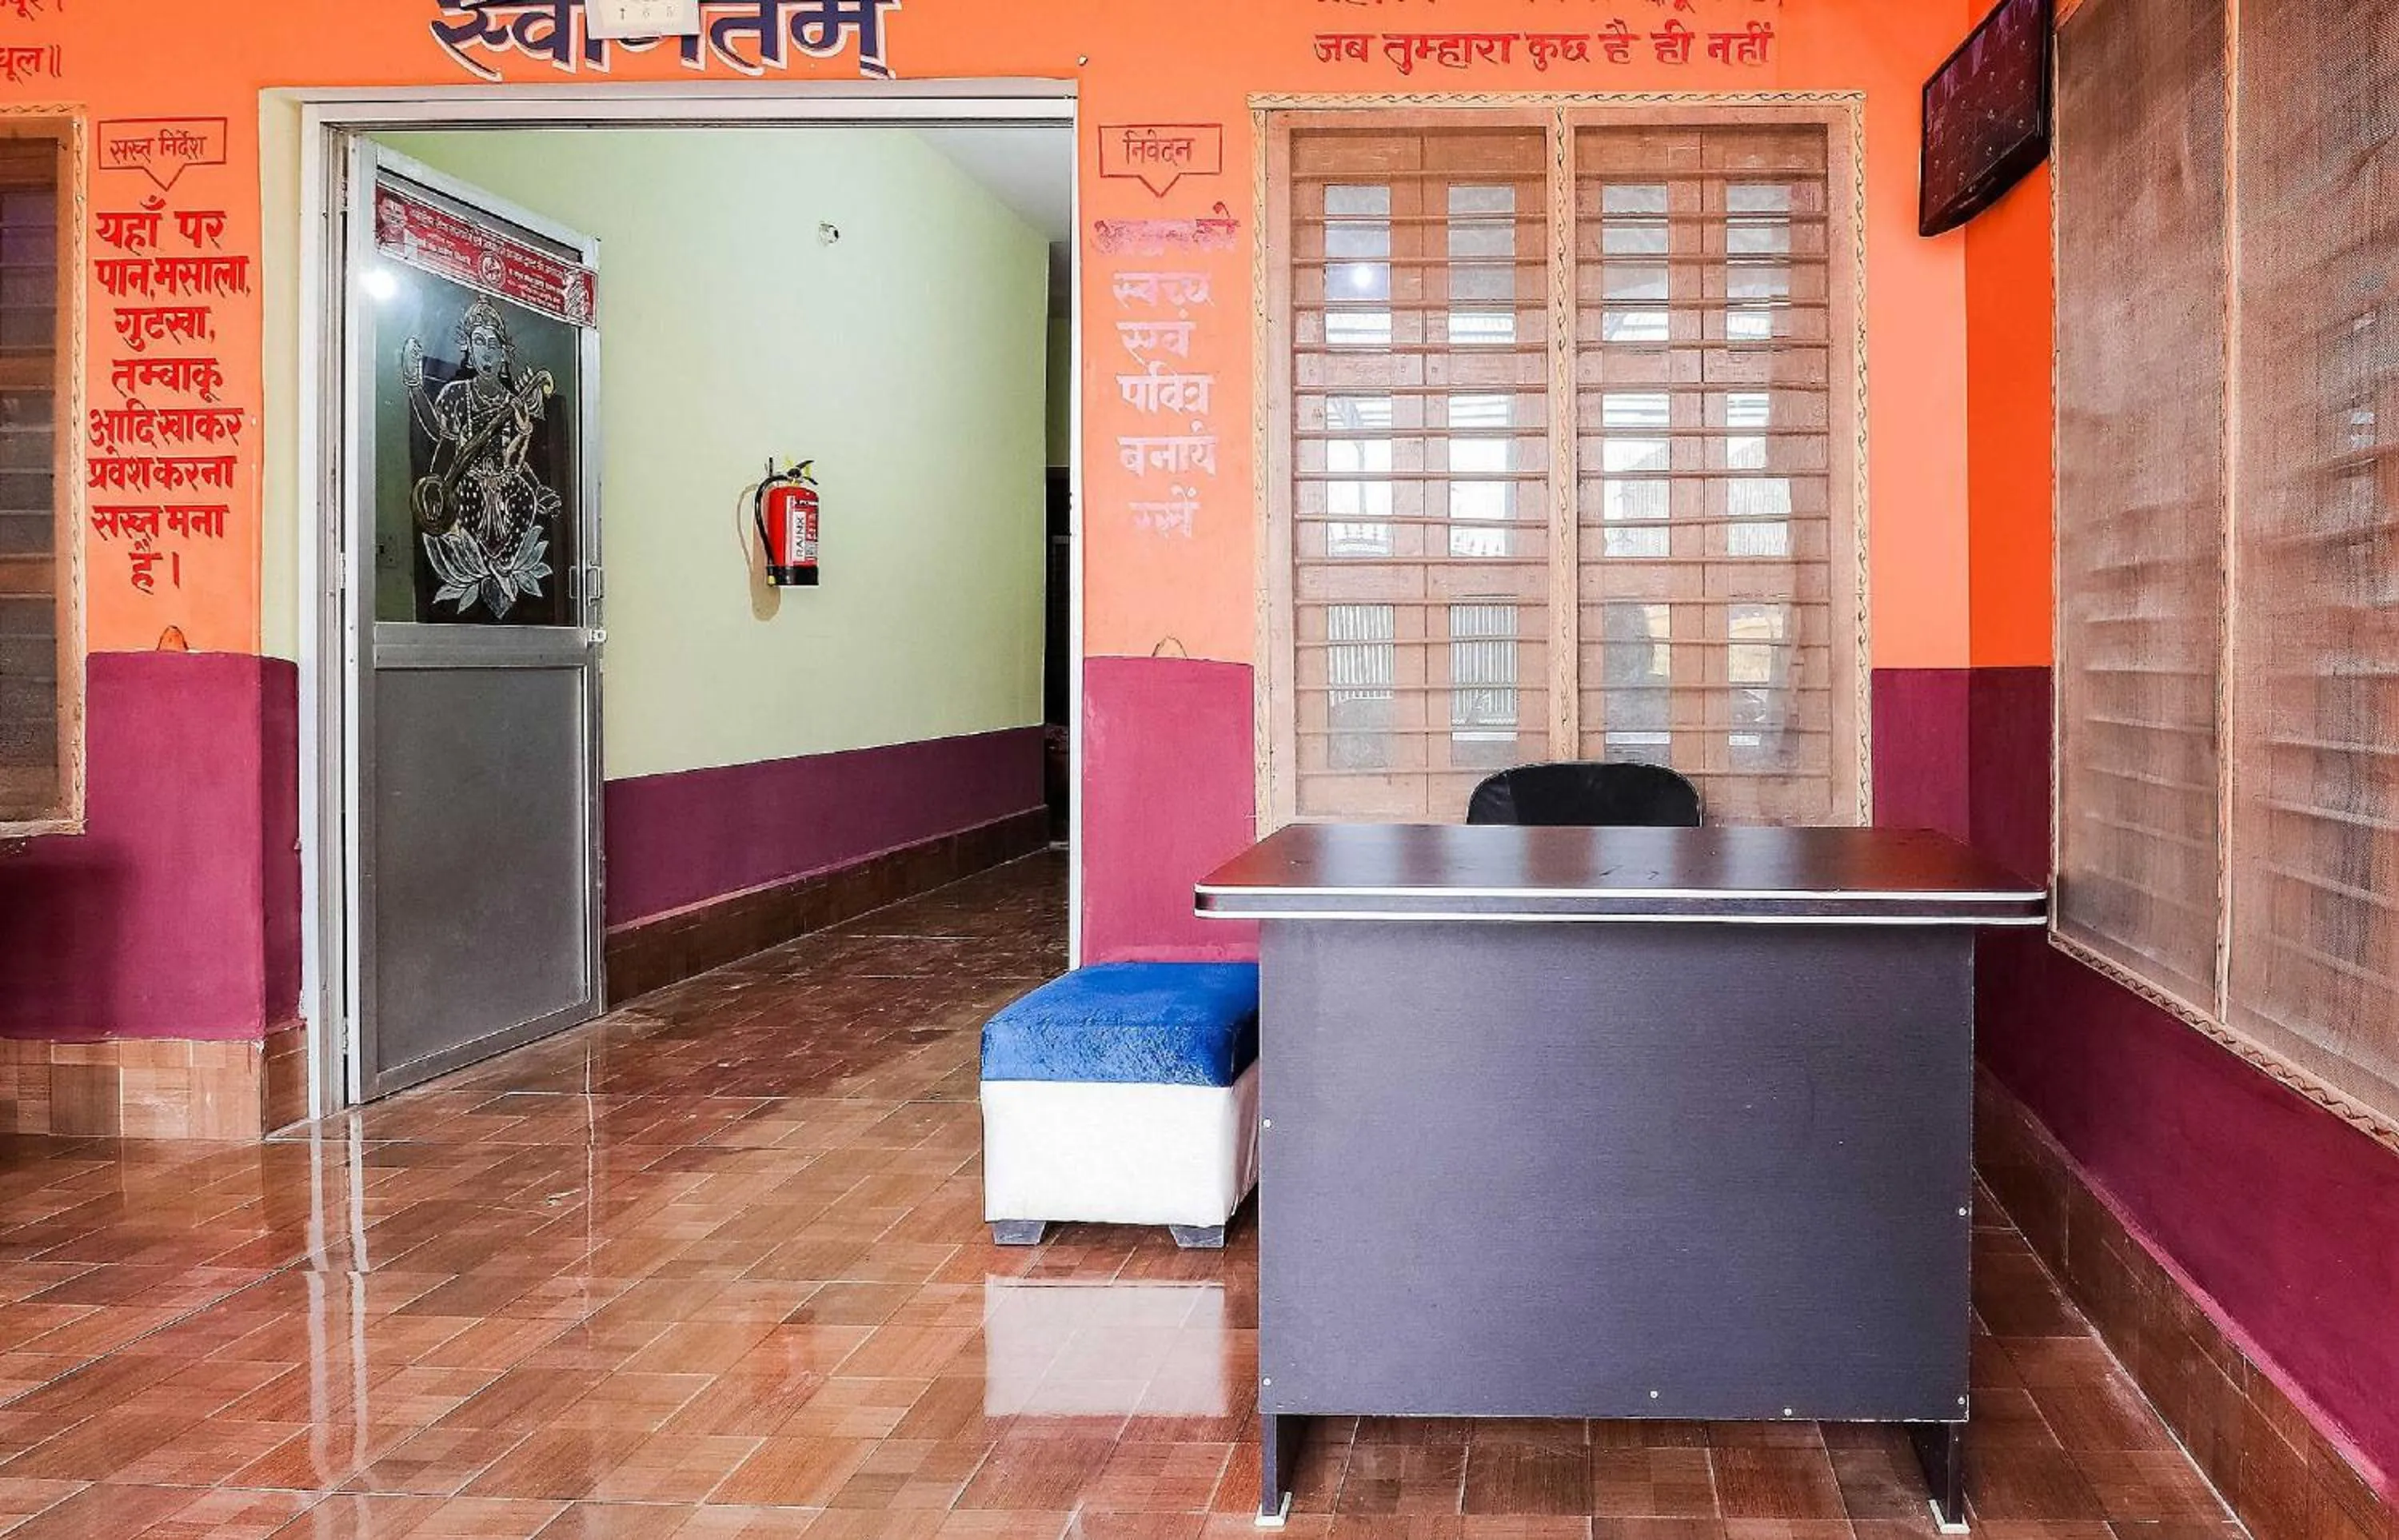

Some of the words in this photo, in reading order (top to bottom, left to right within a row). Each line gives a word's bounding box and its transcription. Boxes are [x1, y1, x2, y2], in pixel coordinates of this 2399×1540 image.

[1315, 34, 1375, 62] जब
[1381, 33, 1520, 75] तुम्हारा
[1524, 32, 1590, 72] कुछ
[1598, 18, 1641, 64] है
[1650, 19, 1695, 65] ही
[1707, 20, 1775, 66] नहीं
[158, 129, 207, 160] निर्देश
[1122, 129, 1196, 166] निवेदन
[96, 195, 166, 256] यहाँ
[174, 210, 227, 249] पर
[111, 357, 223, 403] तम्बाकू
[162, 505, 230, 540] मना
